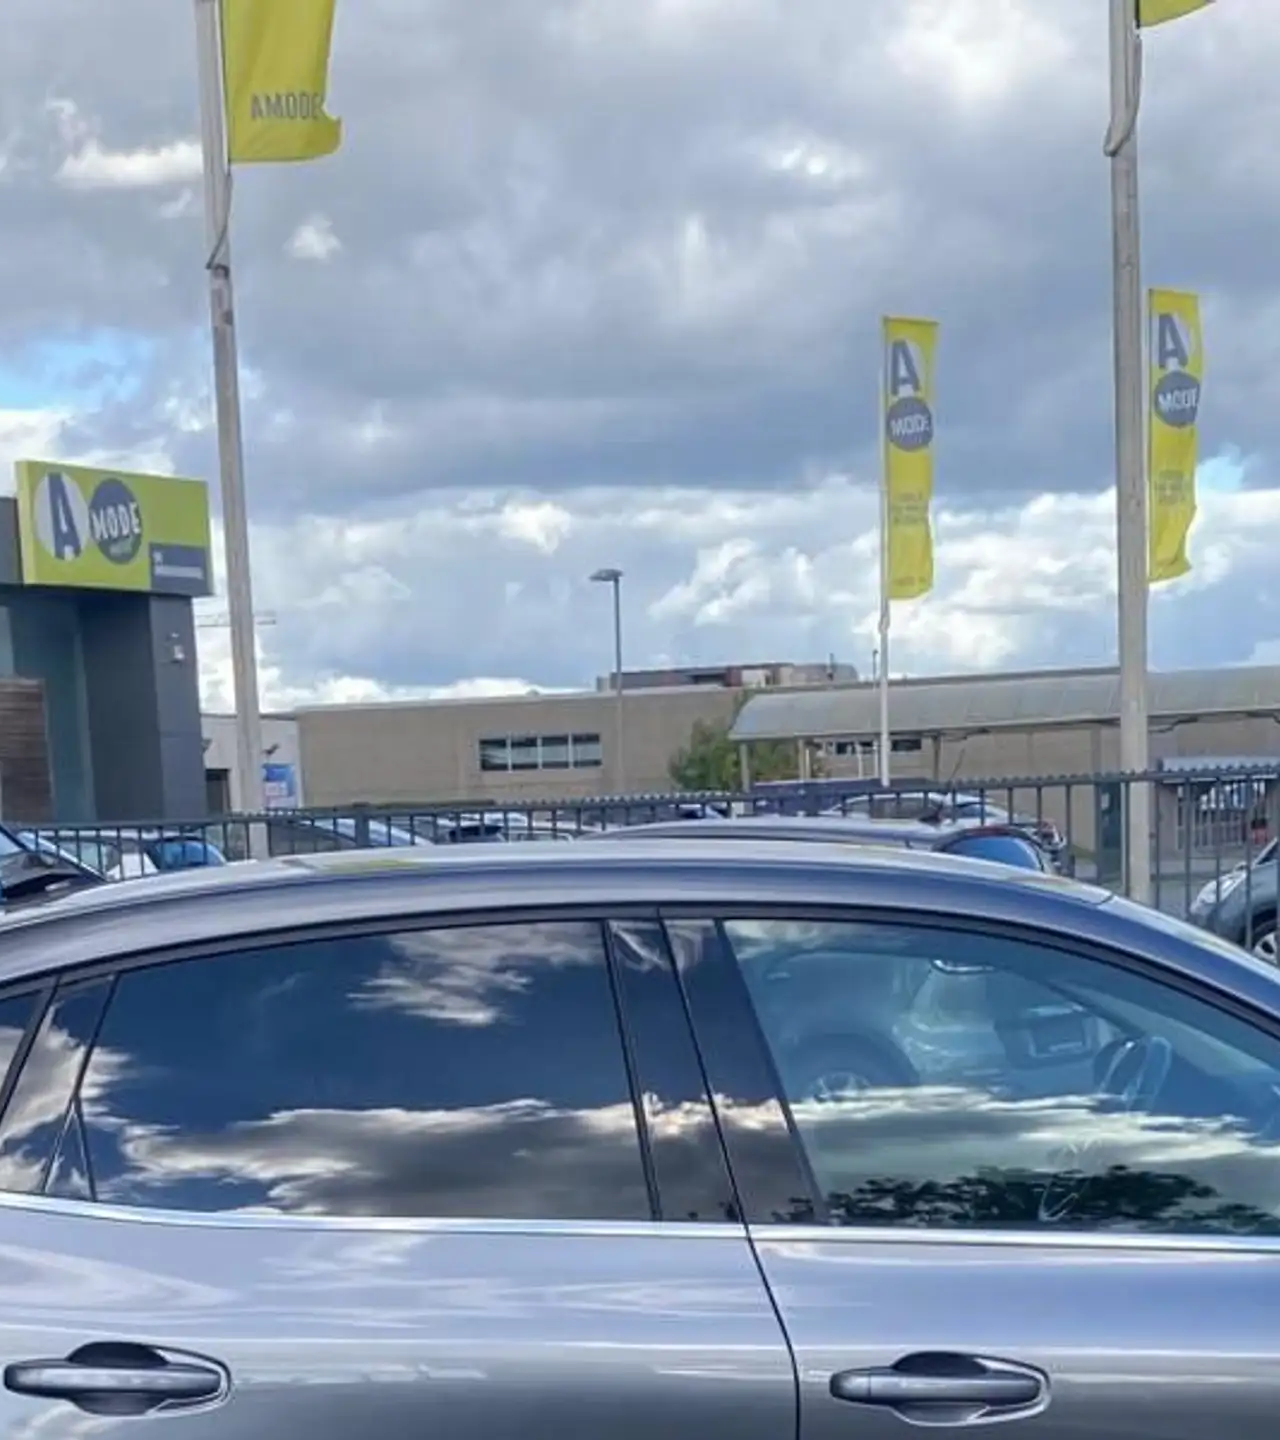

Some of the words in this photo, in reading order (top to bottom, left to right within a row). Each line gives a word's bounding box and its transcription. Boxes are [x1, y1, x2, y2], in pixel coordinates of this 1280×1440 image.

[891, 340, 921, 396] A
[1158, 314, 1188, 369] A
[46, 471, 82, 562] A
[92, 502, 142, 540] MODE
